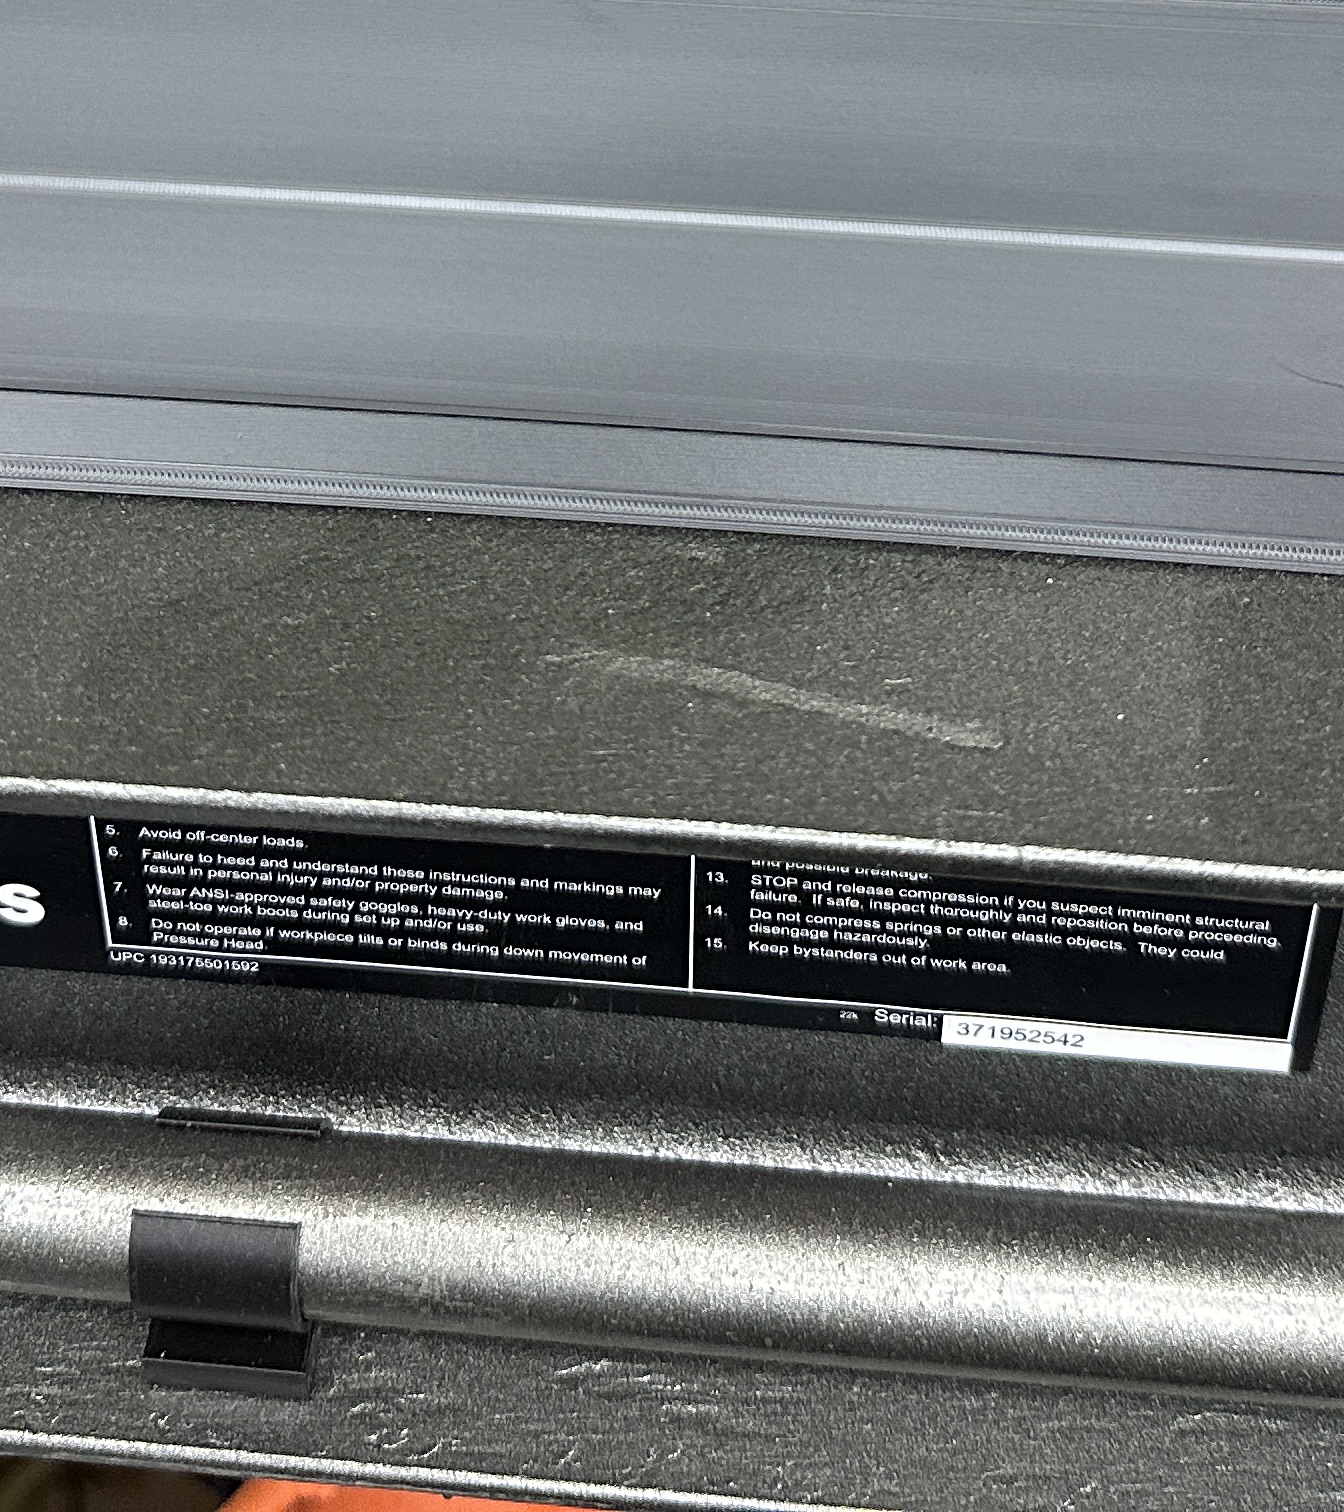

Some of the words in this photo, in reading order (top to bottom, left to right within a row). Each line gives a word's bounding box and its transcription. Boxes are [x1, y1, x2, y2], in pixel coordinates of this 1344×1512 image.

[105, 824, 120, 837] 5.
[138, 826, 182, 840] Avoid
[185, 829, 259, 846] off-center
[262, 834, 308, 849] loads.
[108, 845, 123, 858] 6.
[141, 848, 194, 863] Failure
[198, 853, 214, 864] to
[217, 853, 256, 867] heed
[259, 857, 289, 870] and
[290, 859, 378, 876] understand
[382, 865, 424, 879] these
[429, 867, 516, 885] instructions
[520, 875, 549, 887] and
[553, 878, 624, 895] markings
[628, 884, 662, 898] may
[143, 864, 186, 877] result
[189, 865, 203, 878] in
[207, 869, 273, 883] personal
[277, 871, 318, 889] injury
[322, 876, 372, 890] and/or
[375, 881, 438, 897] property
[441, 883, 508, 901] damage.
[113, 881, 128, 894] 7.
[145, 883, 187, 897] Wear
[189, 886, 306, 906] ANSI-approved
[307, 896, 356, 912] safety
[359, 901, 423, 915] goggles,
[427, 903, 512, 924] heavy-duty
[514, 911, 552, 924] work
[555, 913, 610, 929] gloves,
[614, 918, 644, 930] and
[148, 898, 213, 913] steel-toe
[216, 903, 253, 915] work
[257, 904, 299, 919] boots
[302, 907, 350, 925] during
[354, 913, 378, 924] set
[381, 916, 401, 929] up
[404, 916, 453, 930] and/or
[456, 921, 488, 932] use.
[706, 871, 729, 884] 13.
[750, 872, 798, 889] STOP
[802, 879, 832, 892] and
[836, 881, 894, 897] release
[898, 888, 999, 907] compression
[1003, 895, 1015, 908] if
[1017, 899, 1047, 912] you
[1051, 902, 1114, 918] suspect
[1117, 905, 1191, 924] imminent
[1194, 914, 1271, 931] structural
[750, 886, 802, 904] failure.
[812, 892, 824, 906] If
[826, 895, 864, 910] safe,
[869, 897, 925, 915] inspect
[929, 903, 1013, 925] thoroughly
[1016, 912, 1047, 925] and
[1051, 916, 1129, 933] reposition
[1132, 921, 1184, 937] before
[1188, 928, 1282, 949] proceeding.
[118, 915, 133, 928] 8.
[151, 917, 173, 930] Do
[177, 921, 200, 932] not
[204, 923, 263, 937] operate
[265, 925, 275, 938] if
[278, 928, 354, 944] workpiece
[358, 932, 384, 946] tilts
[387, 937, 404, 947] or
[407, 936, 448, 950] binds
[451, 939, 499, 957] during
[503, 943, 544, 958] down
[548, 949, 628, 964] movement
[631, 953, 648, 965] of
[153, 932, 220, 948] Pressure
[223, 936, 268, 951] Head.
[705, 904, 728, 917] 14.
[749, 906, 772, 920] Do
[776, 911, 801, 923] not
[805, 913, 881, 930] compress
[885, 920, 943, 937] springs
[946, 926, 964, 937] or
[966, 926, 1008, 941] other
[1011, 929, 1063, 946] elastic
[1066, 934, 1127, 951] objects.
[1137, 940, 1177, 958] They
[1181, 946, 1225, 960] could
[748, 921, 829, 941] disengage
[833, 928, 930, 951] hazardously.
[109, 950, 146, 964] UPC
[704, 936, 727, 949] 15.
[748, 941, 789, 959] Keep
[793, 945, 878, 963] bystanders
[881, 954, 907, 965] out
[910, 955, 927, 967] of
[929, 958, 968, 970] work
[971, 961, 1011, 973] area.
[874, 1008, 938, 1027] Serial:
[956, 1022, 1085, 1048] 371952542
